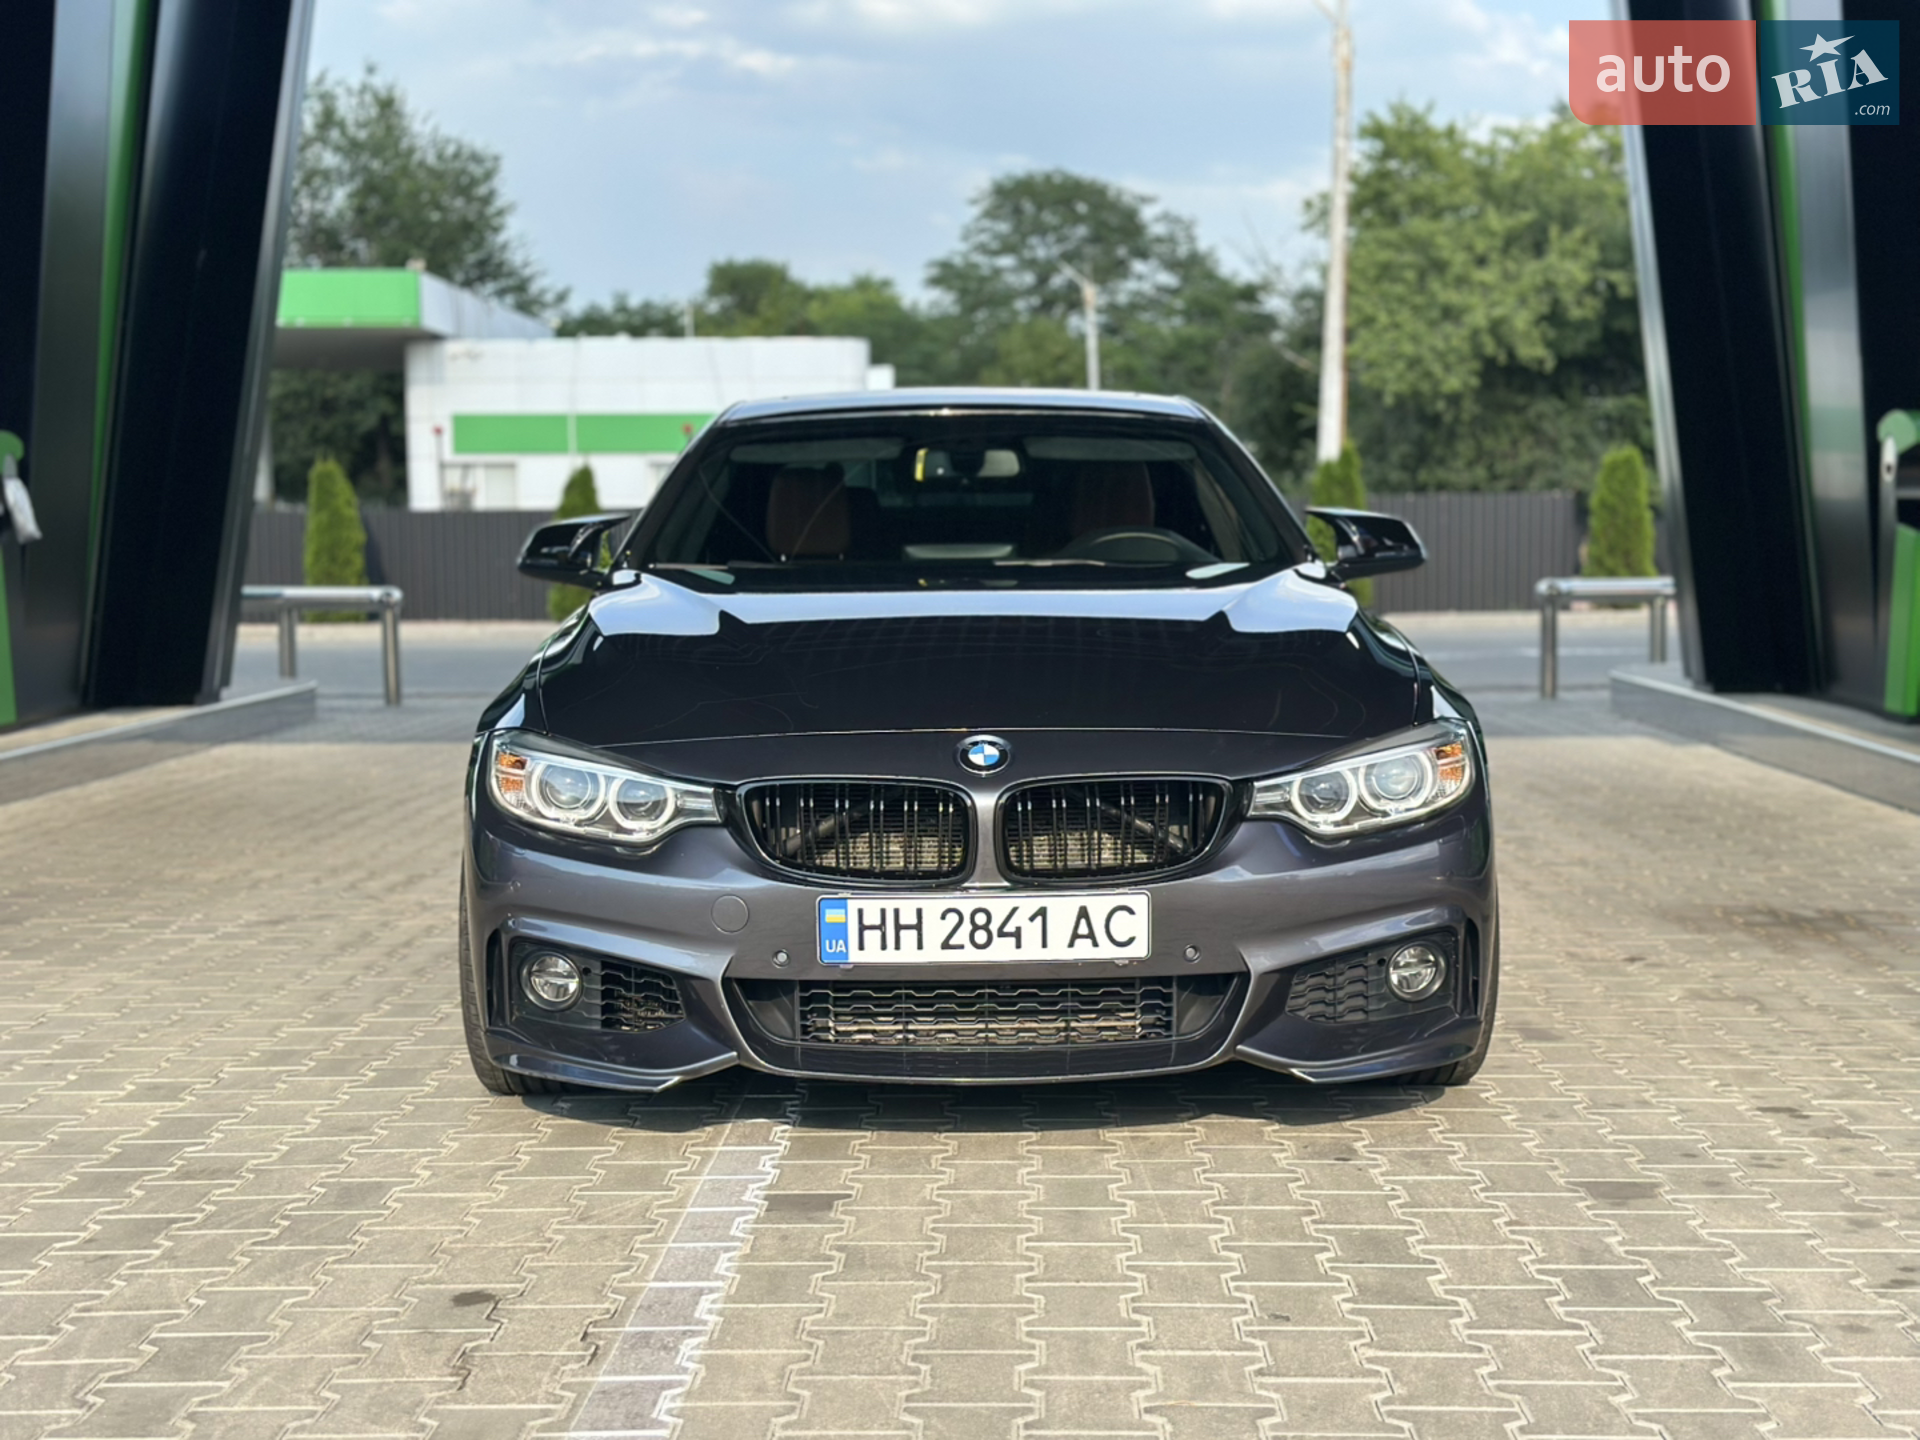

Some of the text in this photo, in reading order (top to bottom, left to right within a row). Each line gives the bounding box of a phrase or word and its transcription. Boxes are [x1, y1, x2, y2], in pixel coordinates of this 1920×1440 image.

[857, 904, 1136, 951] HH 2841 AC
[825, 939, 847, 953] UA
